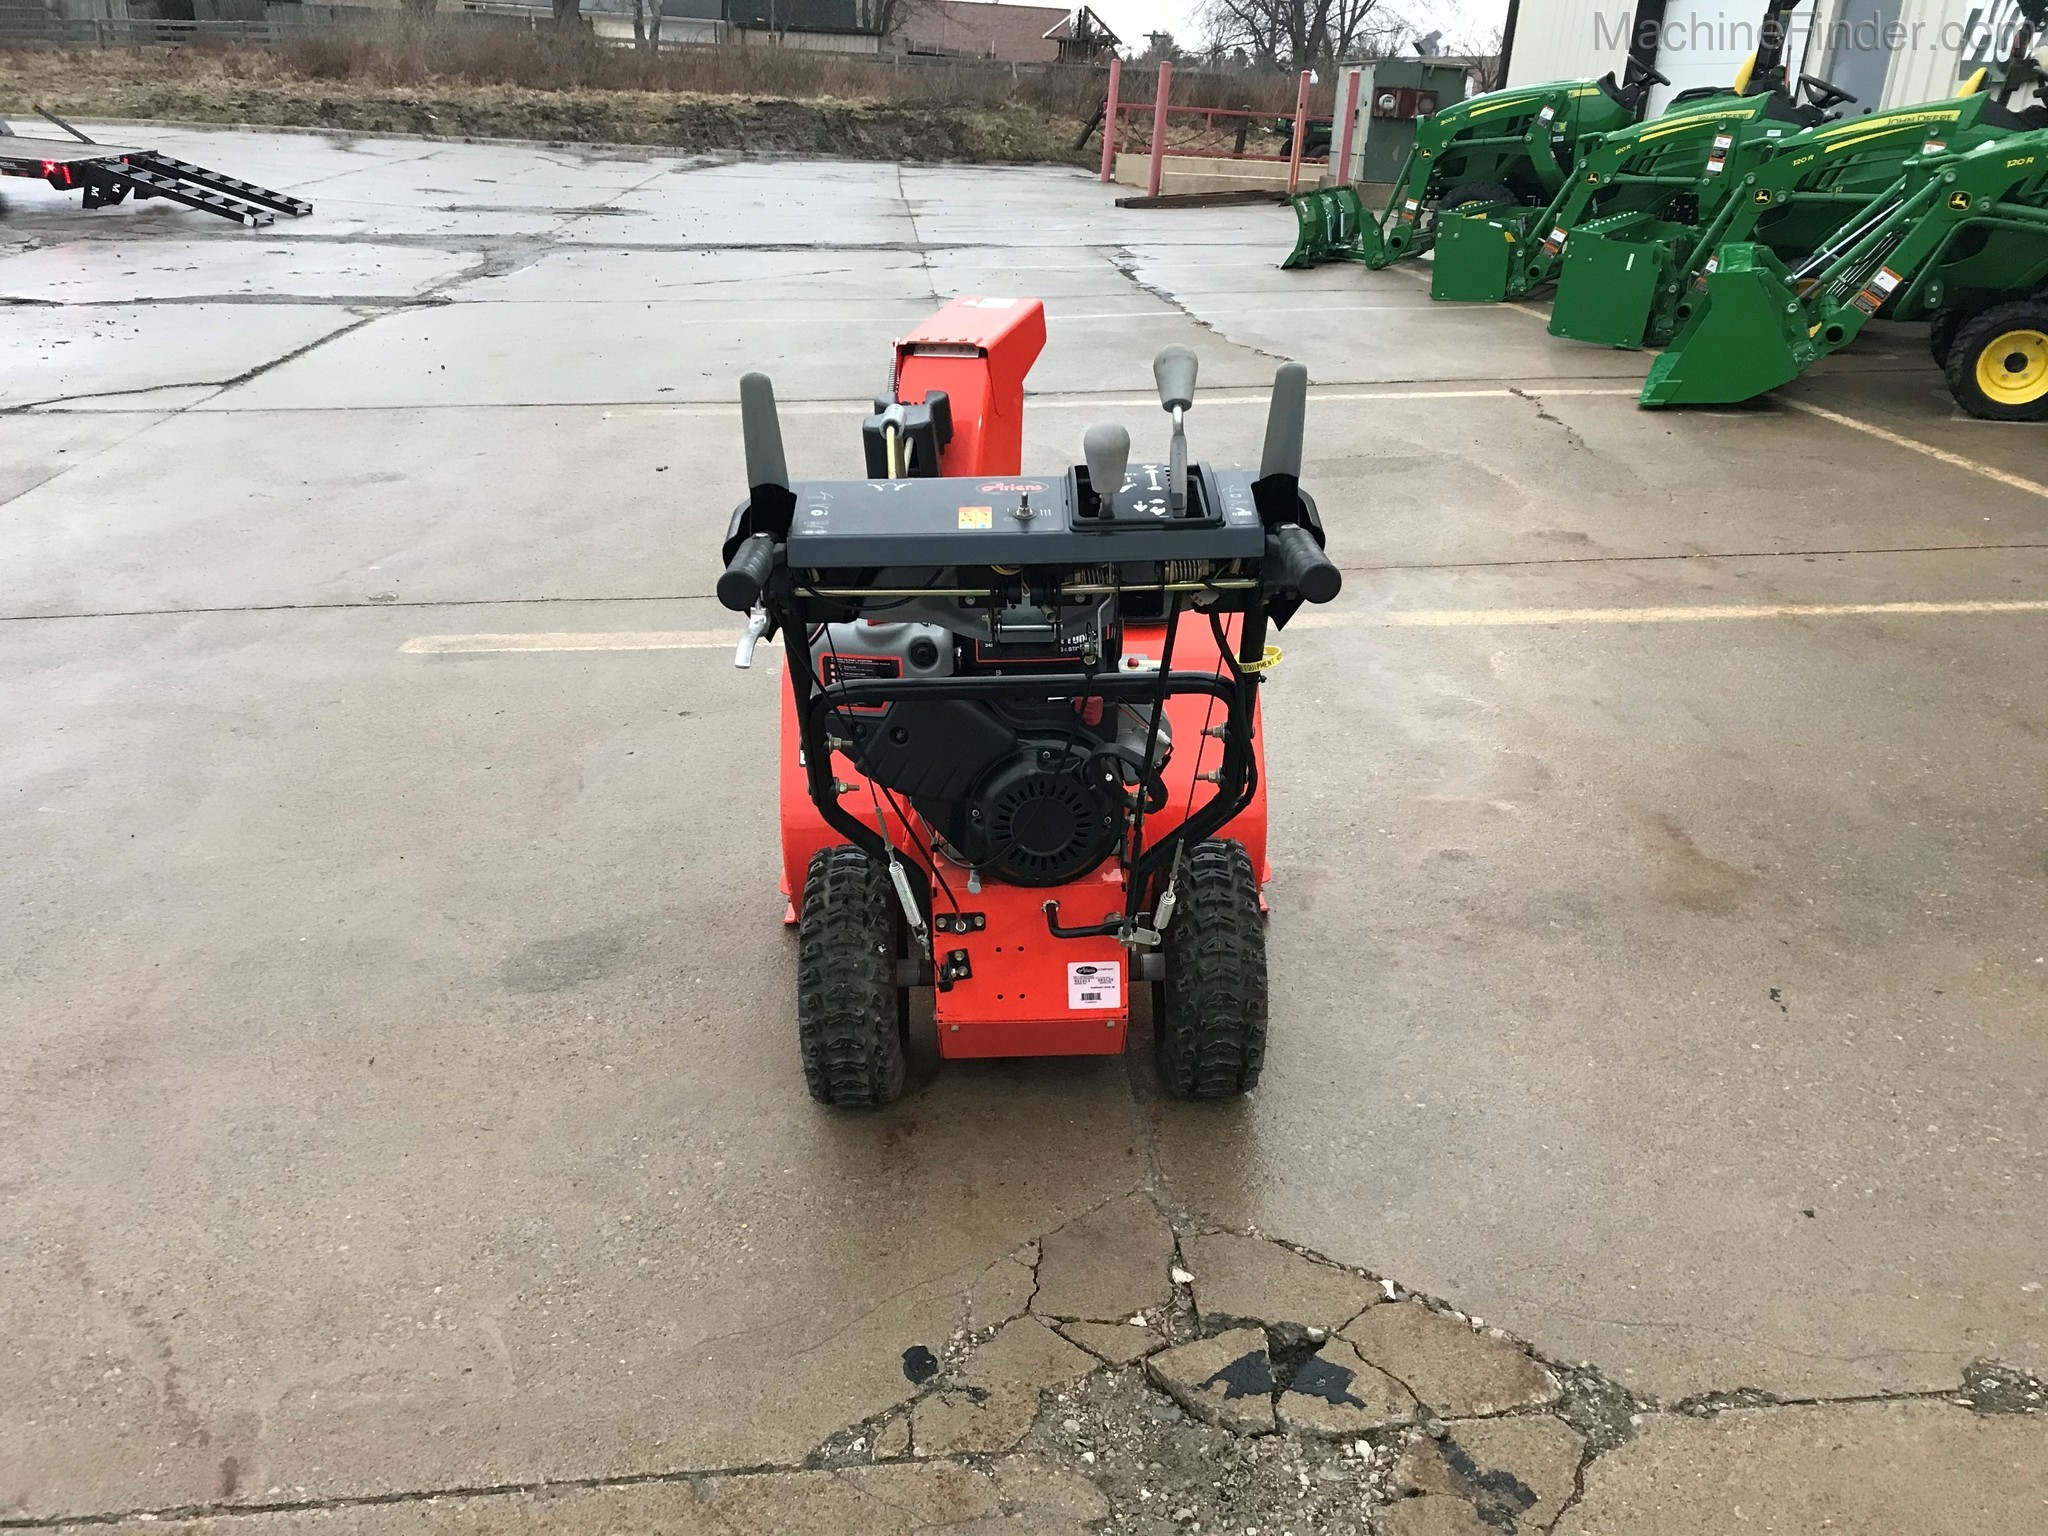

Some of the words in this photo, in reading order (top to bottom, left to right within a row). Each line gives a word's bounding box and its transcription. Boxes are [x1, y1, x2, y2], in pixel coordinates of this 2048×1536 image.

[1887, 116, 1916, 125] JOHN
[981, 483, 1043, 492] Ariens
[1243, 658, 1275, 672] EQUIPMENT
